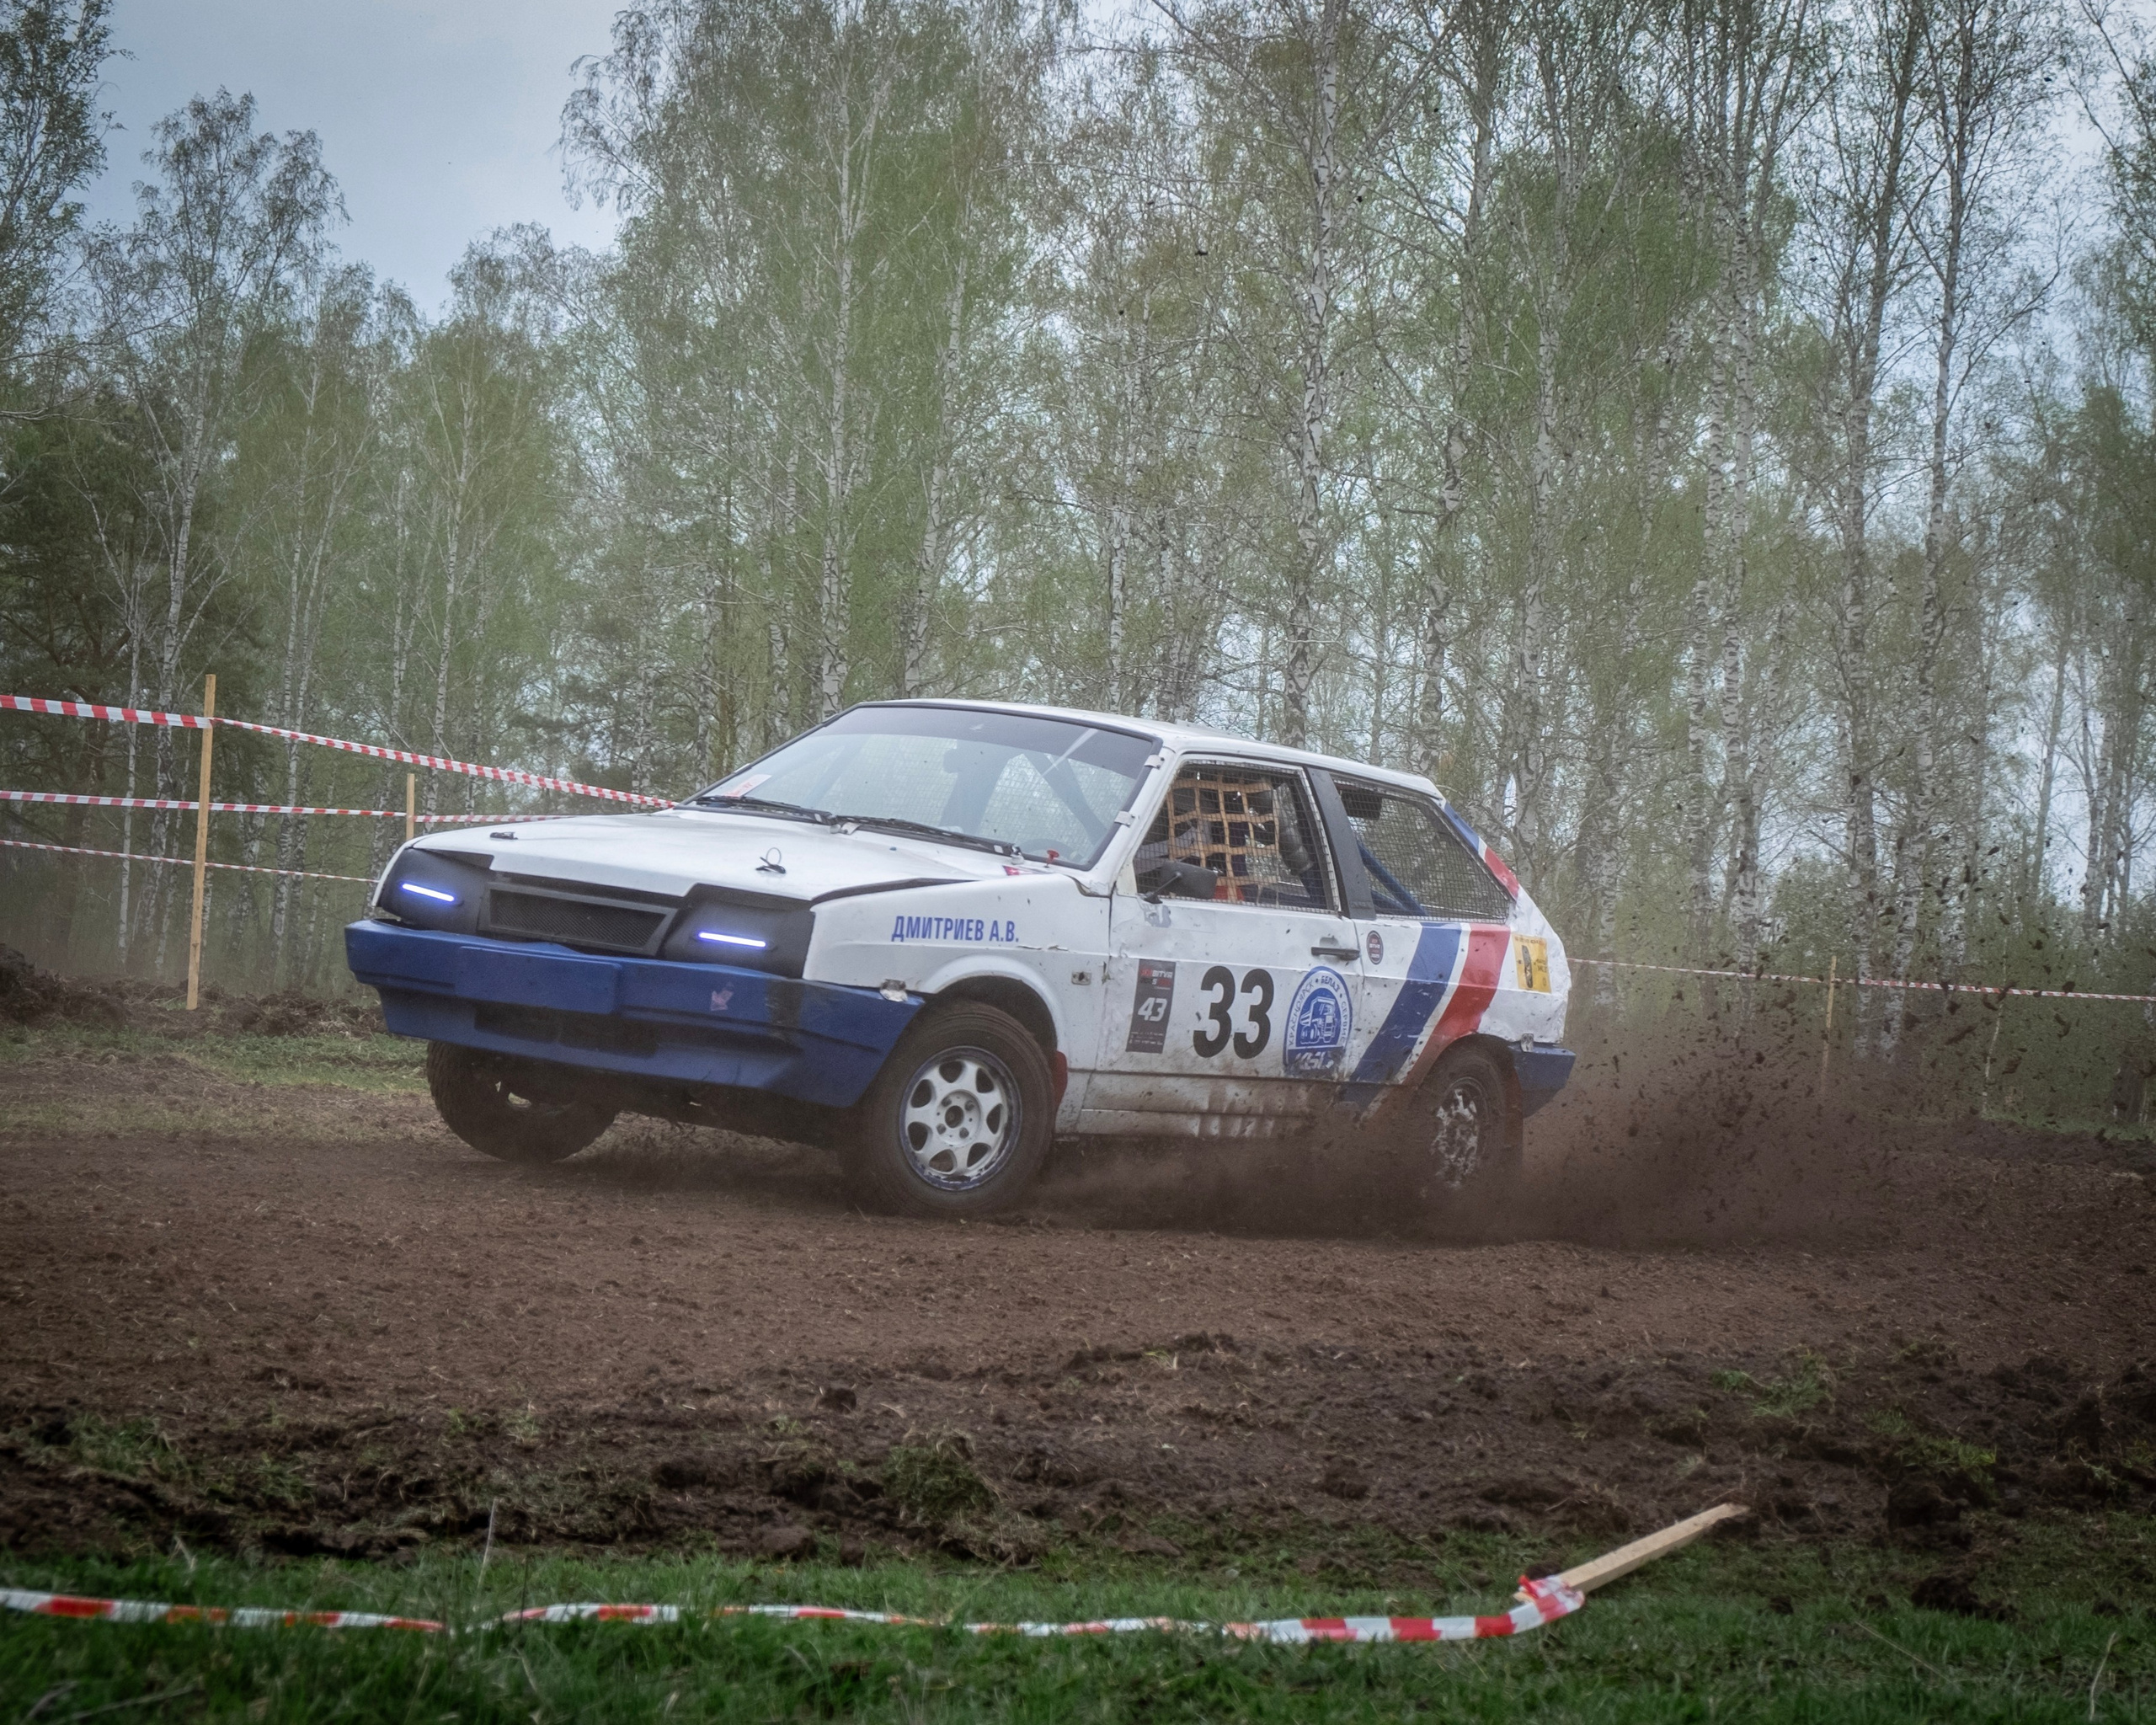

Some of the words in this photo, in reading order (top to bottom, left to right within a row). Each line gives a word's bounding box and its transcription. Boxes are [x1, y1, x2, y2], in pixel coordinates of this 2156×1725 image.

[891, 916, 984, 942] ДМИТРИЕВ
[989, 920, 1019, 943] А.В.
[1137, 997, 1168, 1022] 43
[1193, 965, 1274, 1059] 33
